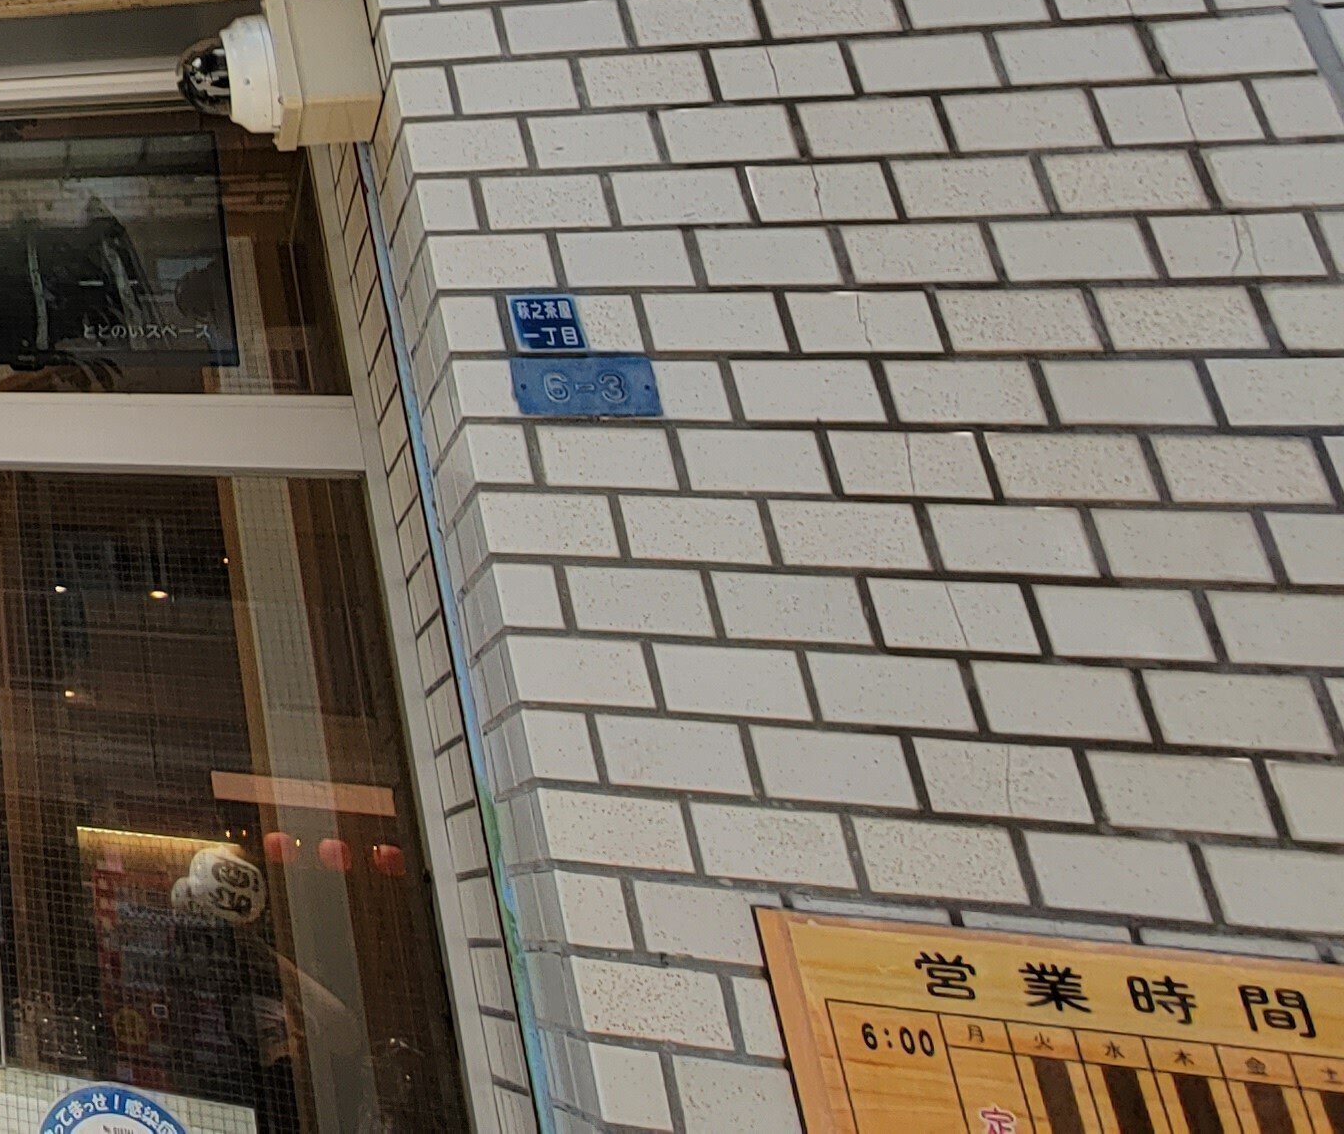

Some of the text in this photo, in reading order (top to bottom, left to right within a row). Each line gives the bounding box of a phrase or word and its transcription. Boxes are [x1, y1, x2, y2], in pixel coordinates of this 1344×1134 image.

[83, 322, 211, 340] ととのいスペース
[522, 326, 580, 346] 一丁目
[542, 372, 629, 403] 6-3
[914, 951, 1318, 1039] 営業時間
[860, 1021, 936, 1057] 6:00
[967, 1024, 1343, 1085] 月 火 水 木 金 土
